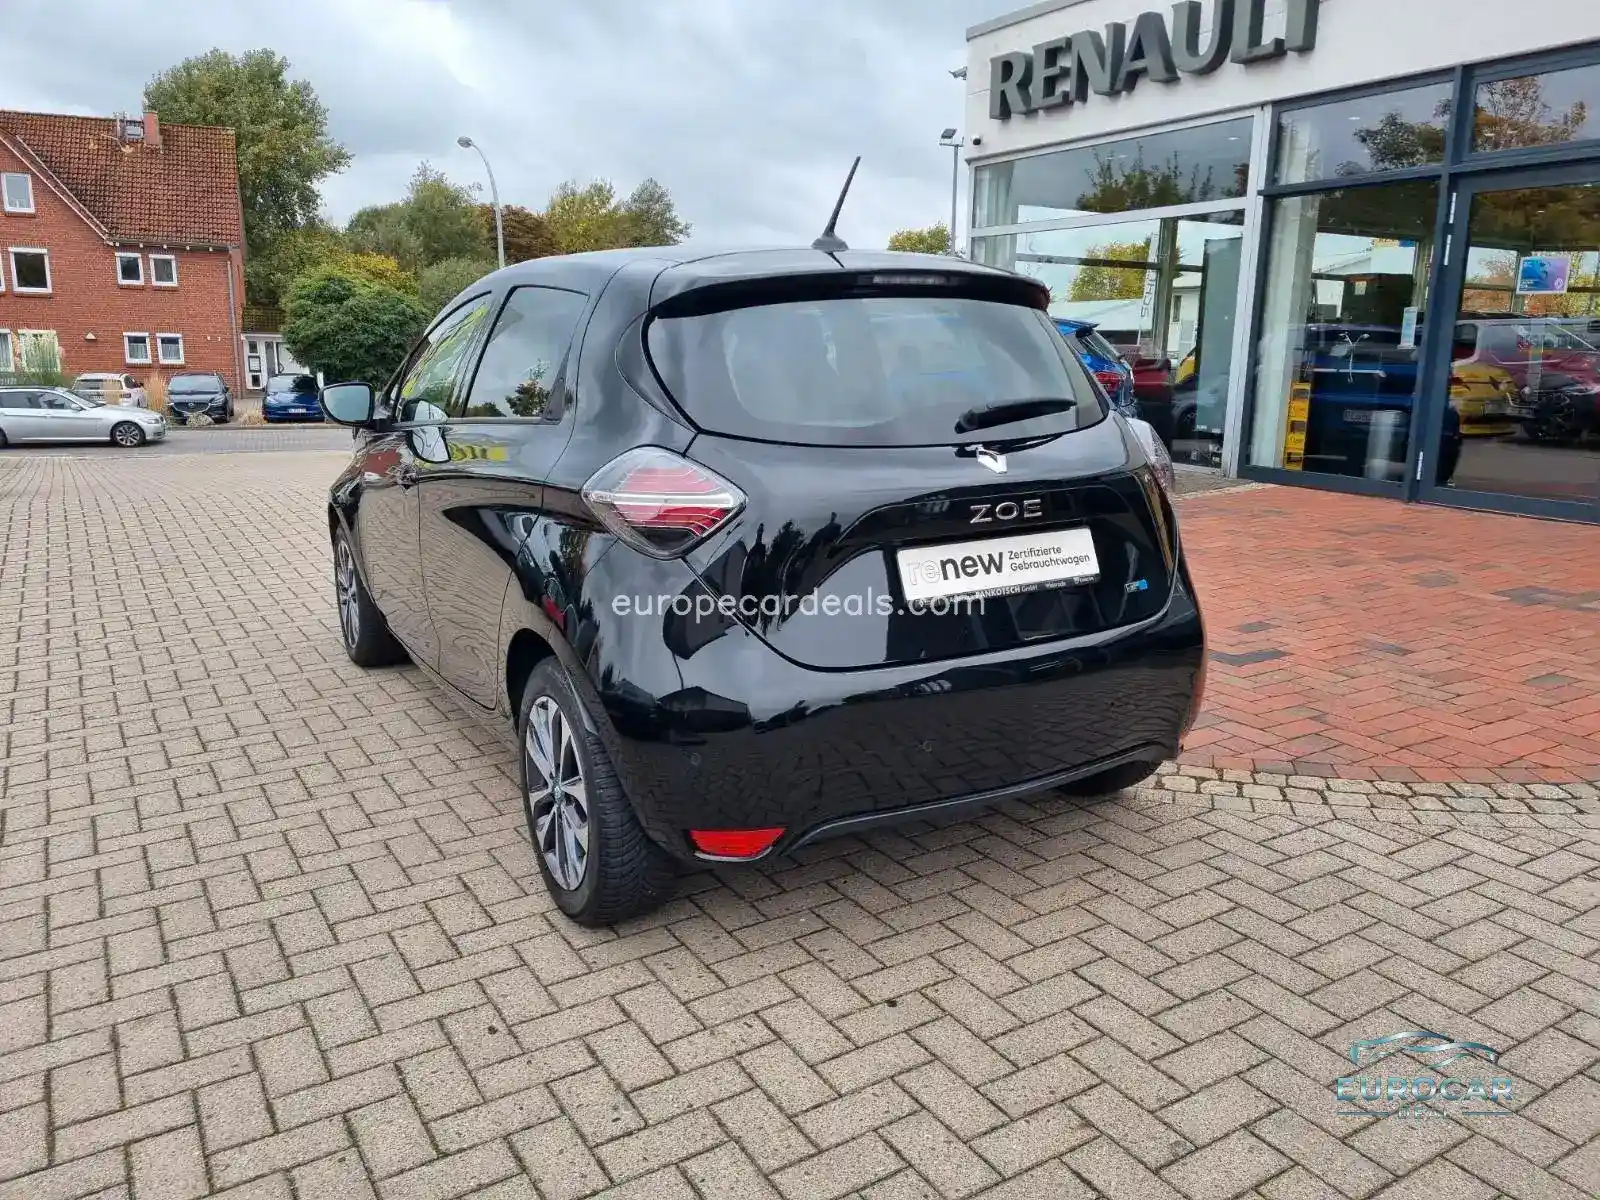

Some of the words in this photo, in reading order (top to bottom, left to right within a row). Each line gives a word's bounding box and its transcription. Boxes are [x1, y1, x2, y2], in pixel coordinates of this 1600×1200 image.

[969, 499, 1043, 524] ZOE
[1007, 546, 1062, 560] Zertifizierte
[1010, 553, 1090, 572] Gebrauchtwagen
[906, 551, 1004, 586] renew
